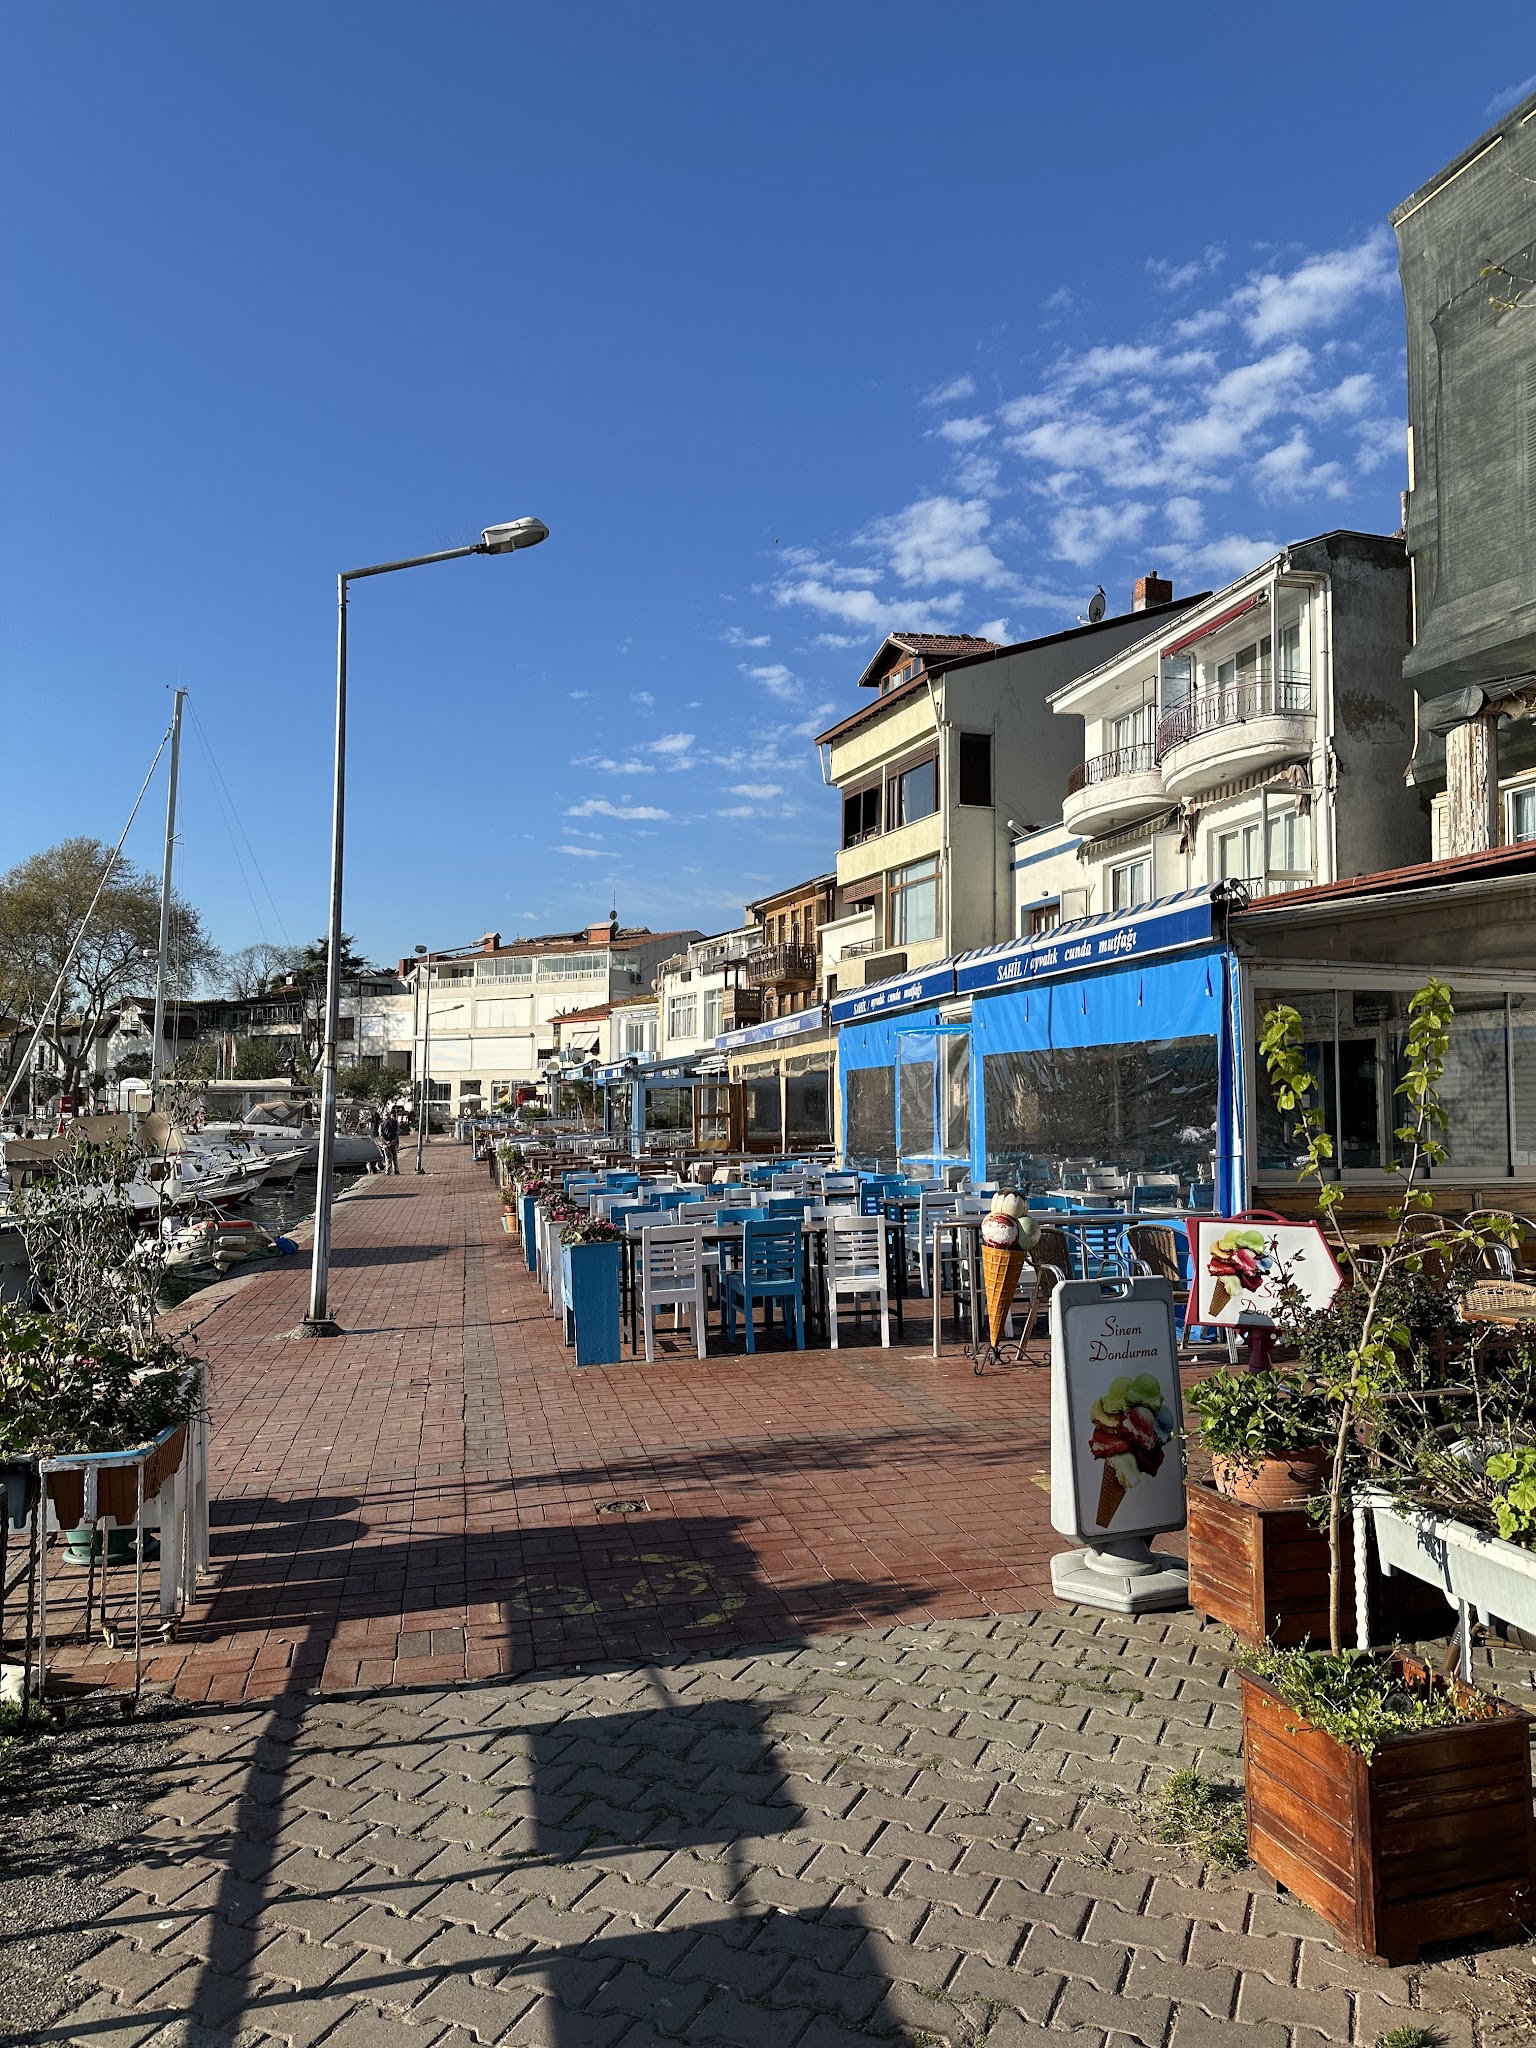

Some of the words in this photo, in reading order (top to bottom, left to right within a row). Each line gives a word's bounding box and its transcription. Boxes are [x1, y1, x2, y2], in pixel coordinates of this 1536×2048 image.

[998, 958, 1022, 981] SAHİL
[1030, 948, 1058, 973] ayvalık
[1064, 939, 1092, 961] cunda
[1098, 929, 1137, 955] mutfağı
[1100, 1315, 1143, 1337] Sinem
[1089, 1339, 1159, 1362] Dondurma
